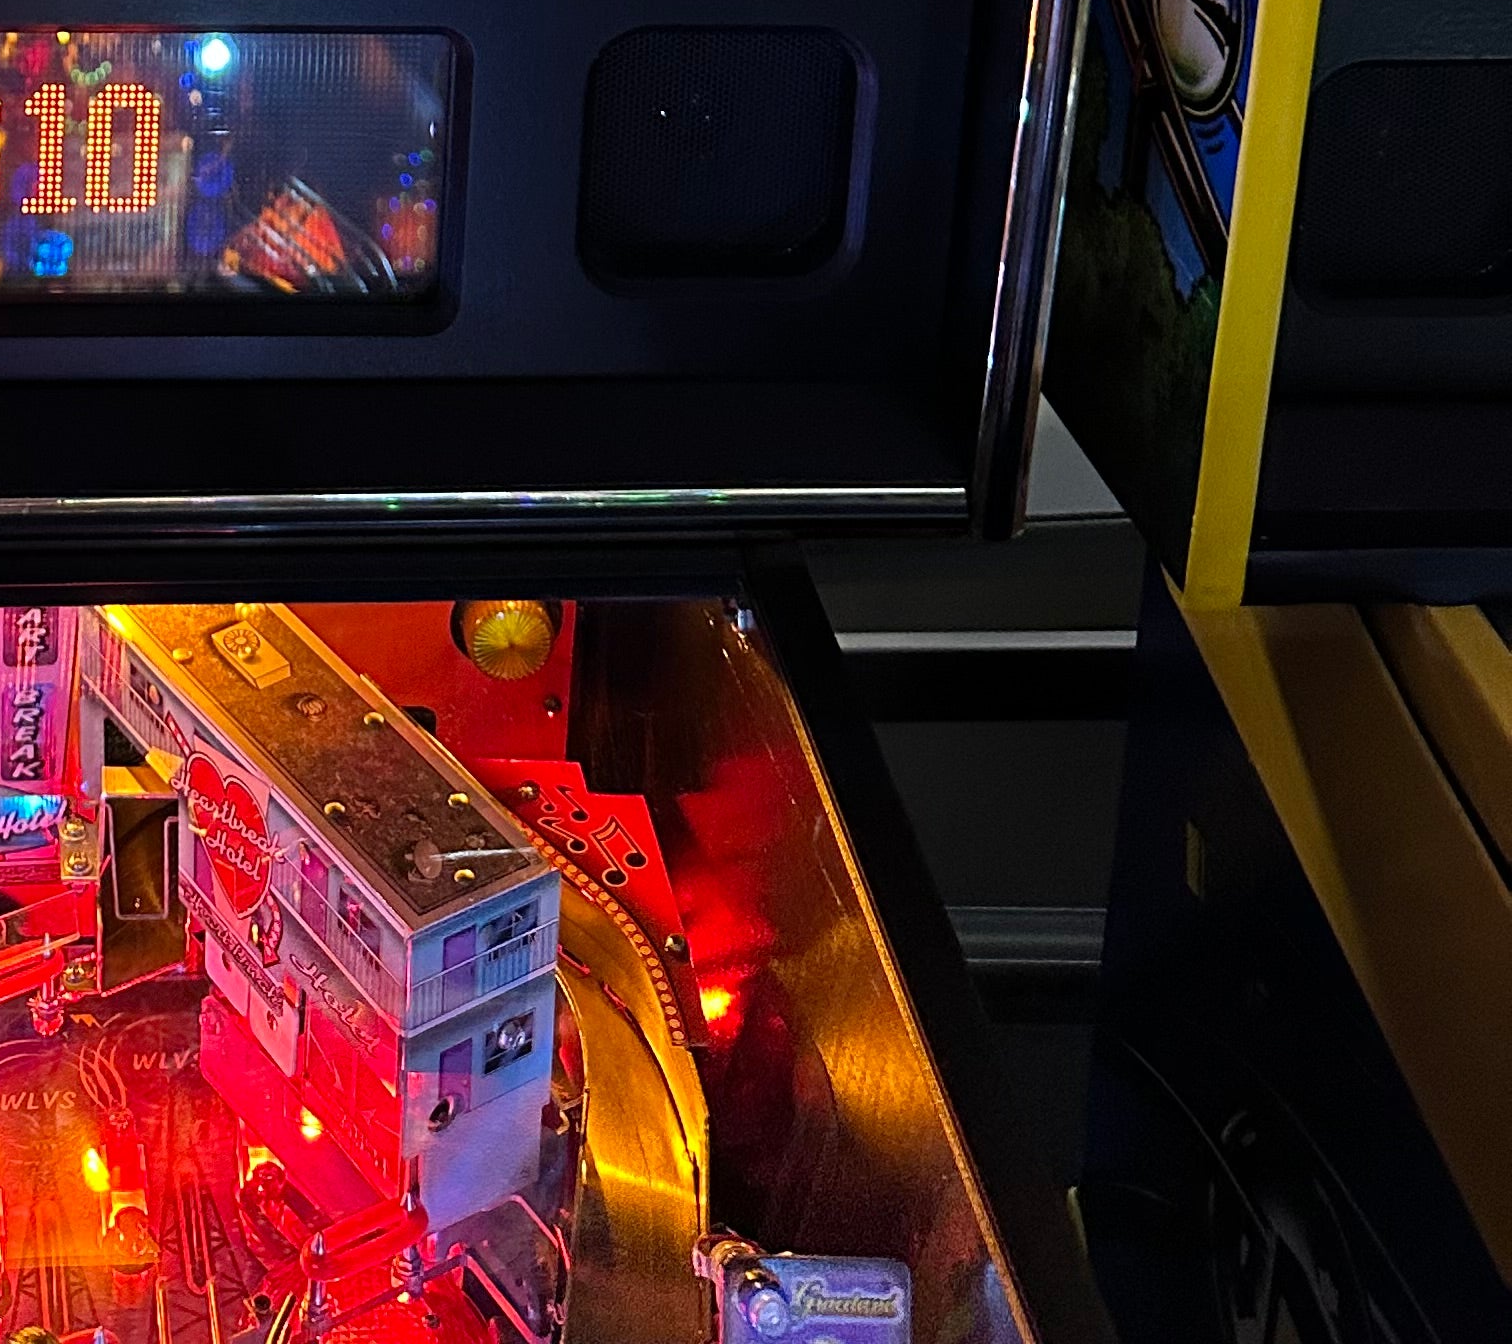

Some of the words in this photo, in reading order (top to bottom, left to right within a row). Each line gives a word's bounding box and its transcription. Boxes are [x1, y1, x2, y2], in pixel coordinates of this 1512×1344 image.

[10, 689, 40, 777] BREAK
[170, 770, 286, 863] Heartbreak
[205, 828, 263, 881] Hotel
[0, 1090, 78, 1112] WLVS
